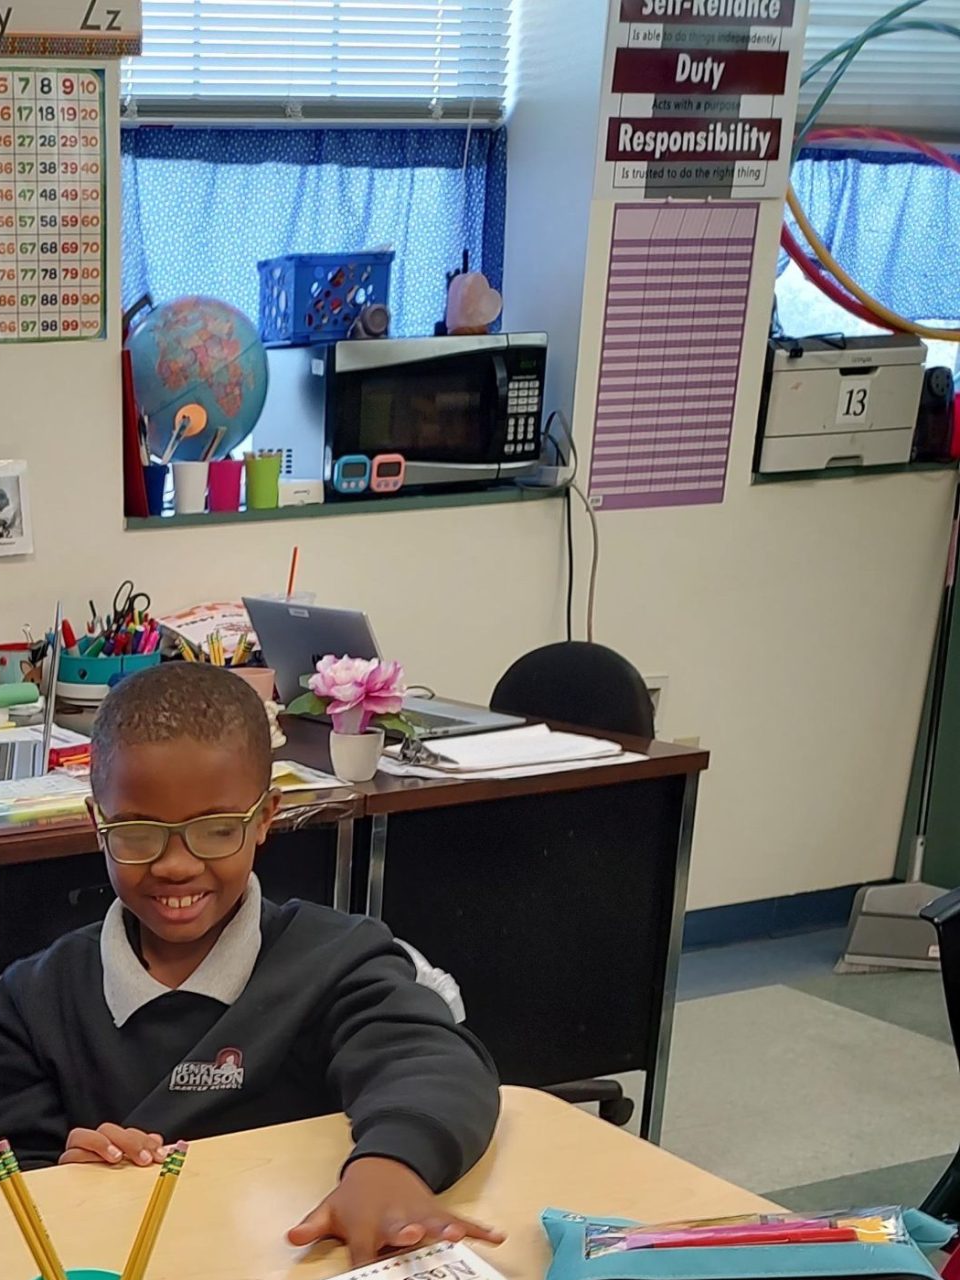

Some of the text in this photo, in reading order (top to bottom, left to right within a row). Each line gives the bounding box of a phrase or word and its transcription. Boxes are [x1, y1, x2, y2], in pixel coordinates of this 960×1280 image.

[641, 0, 780, 18] Self-Reliance
[632, 29, 641, 41] Is
[642, 29, 661, 42] able
[662, 31, 673, 42] to
[675, 31, 686, 42] do
[717, 31, 778, 47] independently
[675, 53, 726, 91] Duty
[19, 77, 30, 94] 7
[40, 77, 52, 94] 8
[62, 78, 74, 95] 9
[81, 77, 96, 94] 10
[17, 106, 33, 121] 17
[38, 106, 55, 121] 18
[61, 107, 77, 121] 19
[81, 108, 98, 120] 20
[652, 100, 741, 114] Acts with a purpose
[17, 135, 34, 147] 27
[39, 135, 56, 147] 28
[61, 135, 78, 148] 29
[82, 135, 98, 147] 30
[618, 122, 771, 159] Responsibility
[18, 162, 34, 174] 37
[40, 162, 56, 174] 38
[61, 162, 78, 174] 39
[621, 166, 761, 181] Is trusted to do the right thing
[18, 189, 35, 201] 47
[40, 189, 57, 201] 48
[61, 189, 78, 201] 49
[19, 215, 35, 228] 57
[40, 215, 57, 227] 58
[62, 215, 78, 227] 59
[81, 215, 99, 227] 60
[20, 242, 36, 254] 67
[40, 242, 57, 254] 68
[61, 242, 78, 254] 69
[81, 242, 99, 253] 70
[0, 269, 15, 281] 76
[21, 268, 36, 280] 77
[41, 268, 57, 280] 78
[62, 268, 78, 280] 79
[81, 268, 99, 279] 80
[20, 294, 36, 306] 87
[41, 294, 58, 306] 88
[62, 294, 78, 305] 89
[81, 293, 99, 305] 90
[0, 321, 16, 332] 96
[21, 321, 36, 332] 97
[41, 320, 57, 331] 98
[62, 320, 78, 331] 99
[842, 389, 868, 416] 13
[169, 1067, 244, 1090] JOHNSON
